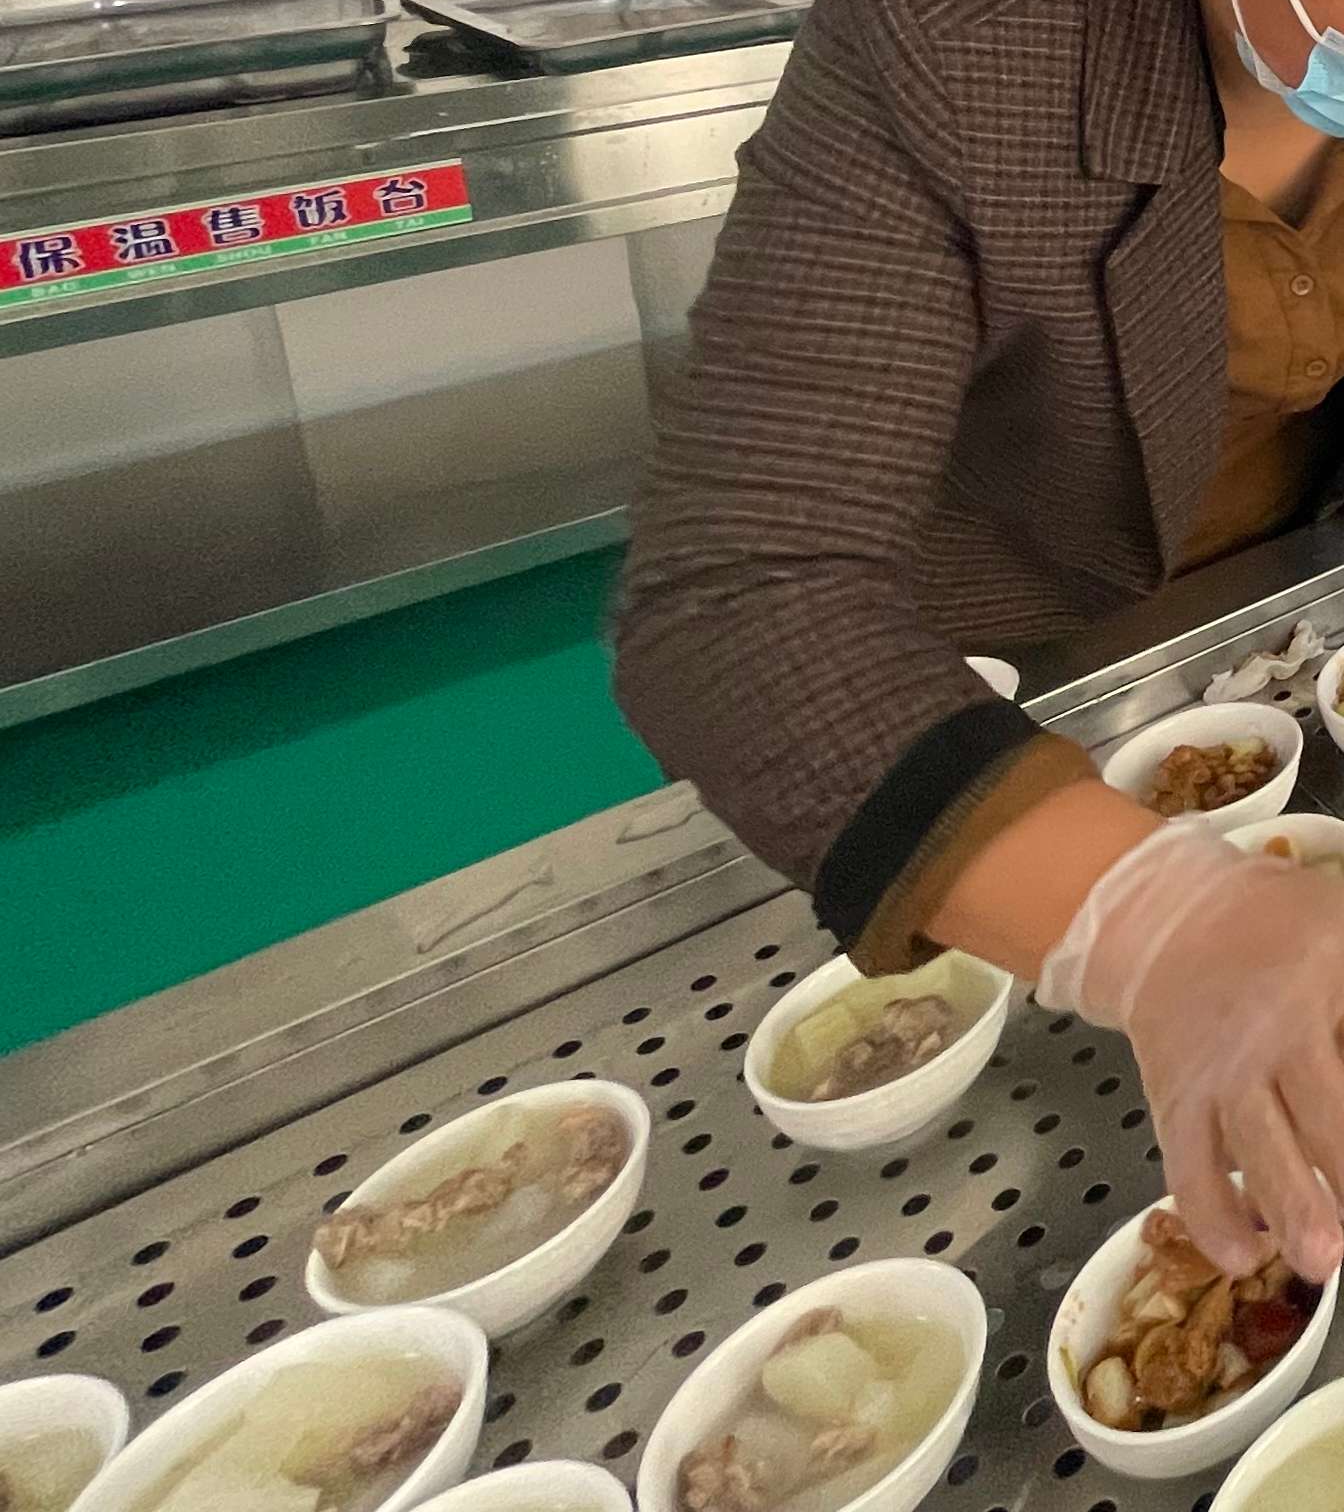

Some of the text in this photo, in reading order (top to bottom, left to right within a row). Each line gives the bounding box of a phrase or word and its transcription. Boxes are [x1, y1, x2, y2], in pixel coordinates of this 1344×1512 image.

[17, 178, 427, 280] 保温售饭台
